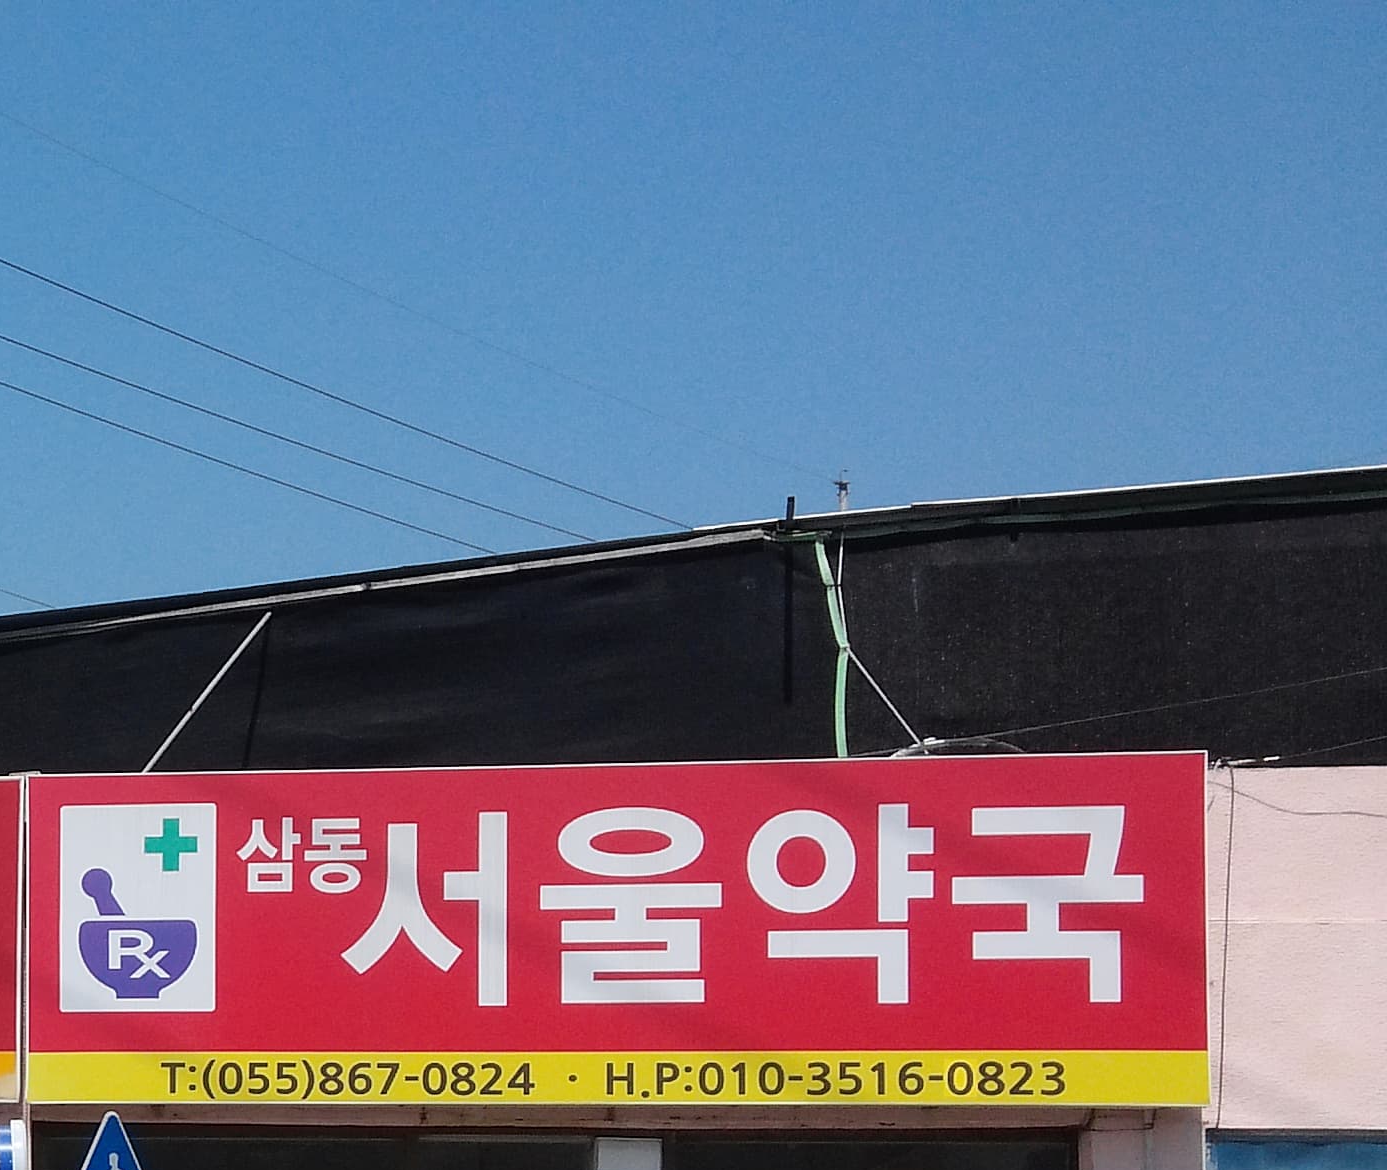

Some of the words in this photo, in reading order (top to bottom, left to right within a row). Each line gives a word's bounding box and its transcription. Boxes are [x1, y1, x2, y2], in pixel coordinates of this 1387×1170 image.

[236, 816, 368, 894] 삼동
[340, 803, 1145, 1007] 서울약국
[161, 1061, 536, 1098] T:(055)867-0824
[605, 1061, 1066, 1099] H.P:010-3516-0823
